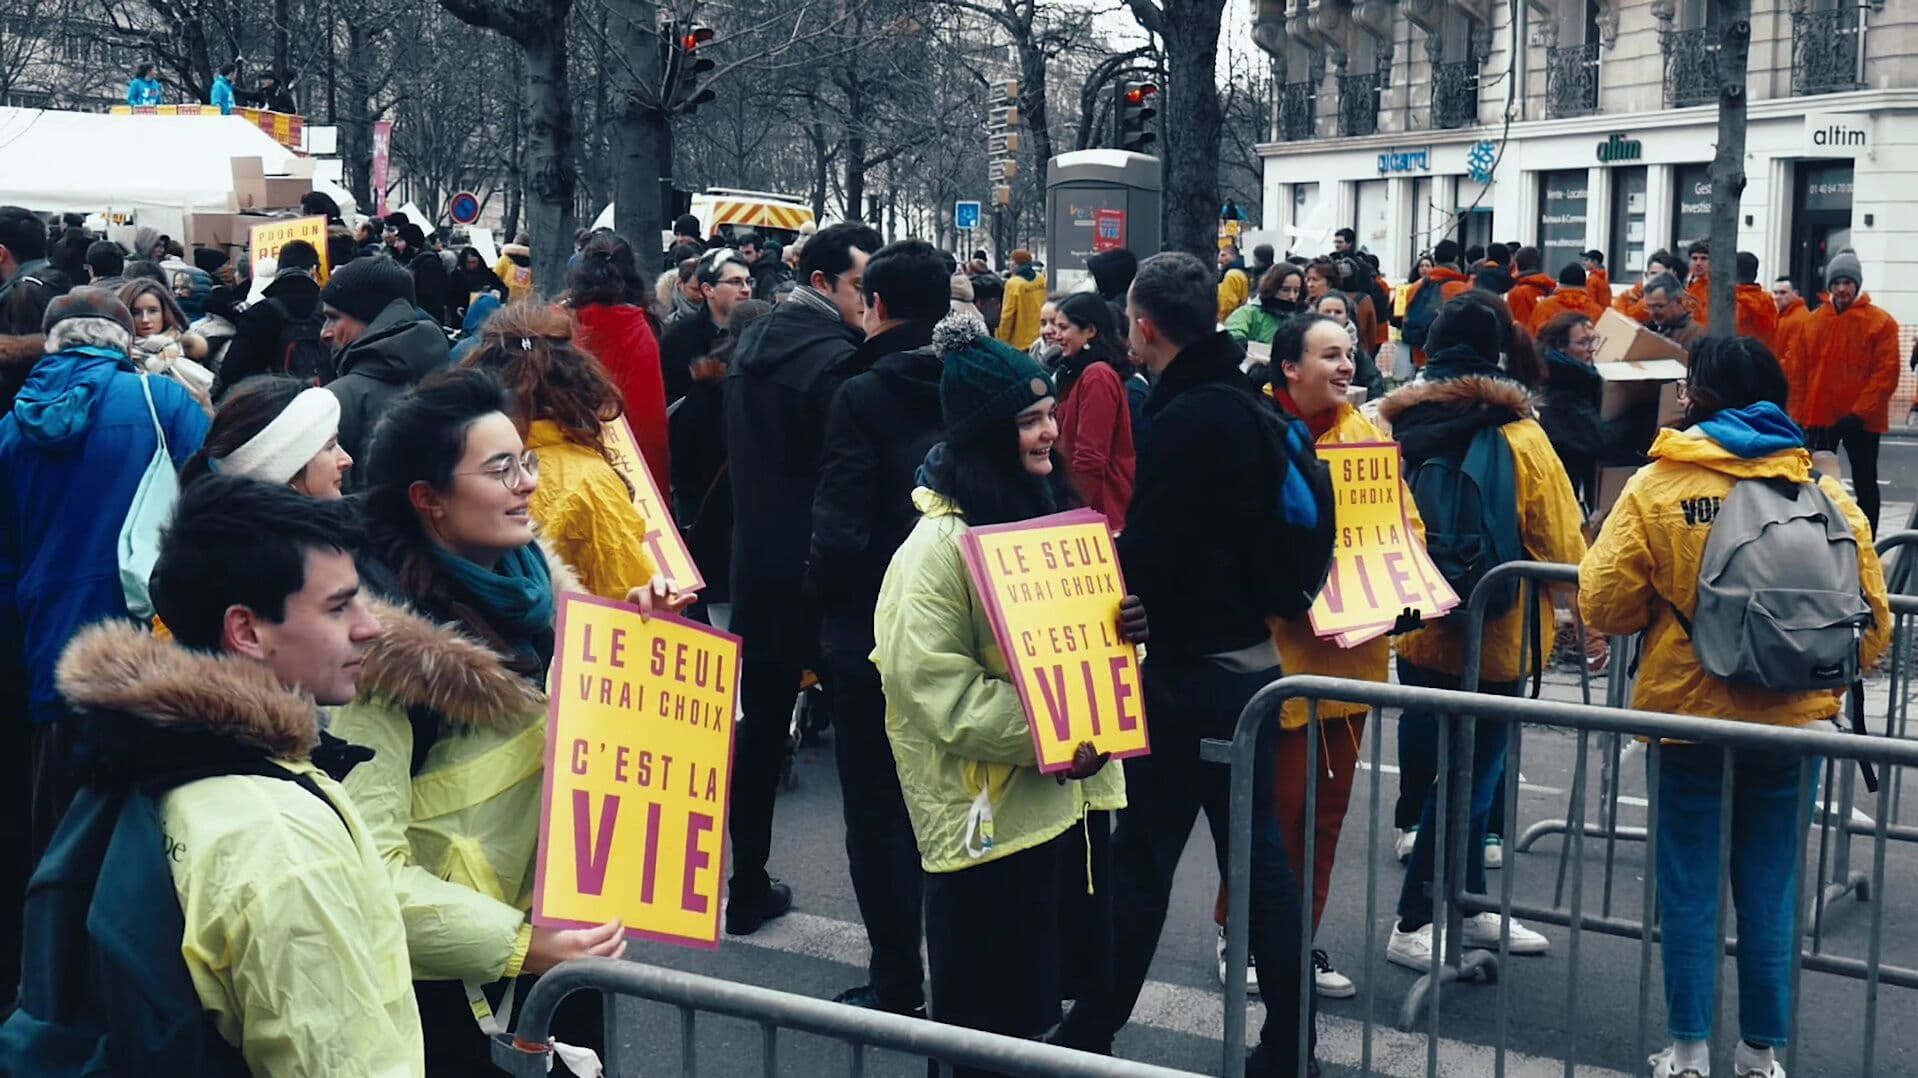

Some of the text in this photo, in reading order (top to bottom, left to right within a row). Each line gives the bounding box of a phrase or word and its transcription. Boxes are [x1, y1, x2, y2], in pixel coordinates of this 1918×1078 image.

[1814, 125, 1866, 146] altim
[1378, 147, 1430, 175] picard
[1343, 456, 1393, 483] SEUL
[1350, 487, 1394, 505] CHOIX
[1375, 524, 1400, 545] LA
[996, 535, 1108, 577] LE SEUL
[1006, 572, 1116, 604] VRAI CHOIX
[1322, 552, 1422, 614] VIE
[582, 623, 726, 694] LE SEUL
[1021, 622, 1090, 658] C'EST
[579, 673, 724, 733] VRAI CHOIX
[1032, 655, 1138, 742] VIE
[571, 738, 718, 803] C'EST LA
[571, 788, 714, 914] VIE
